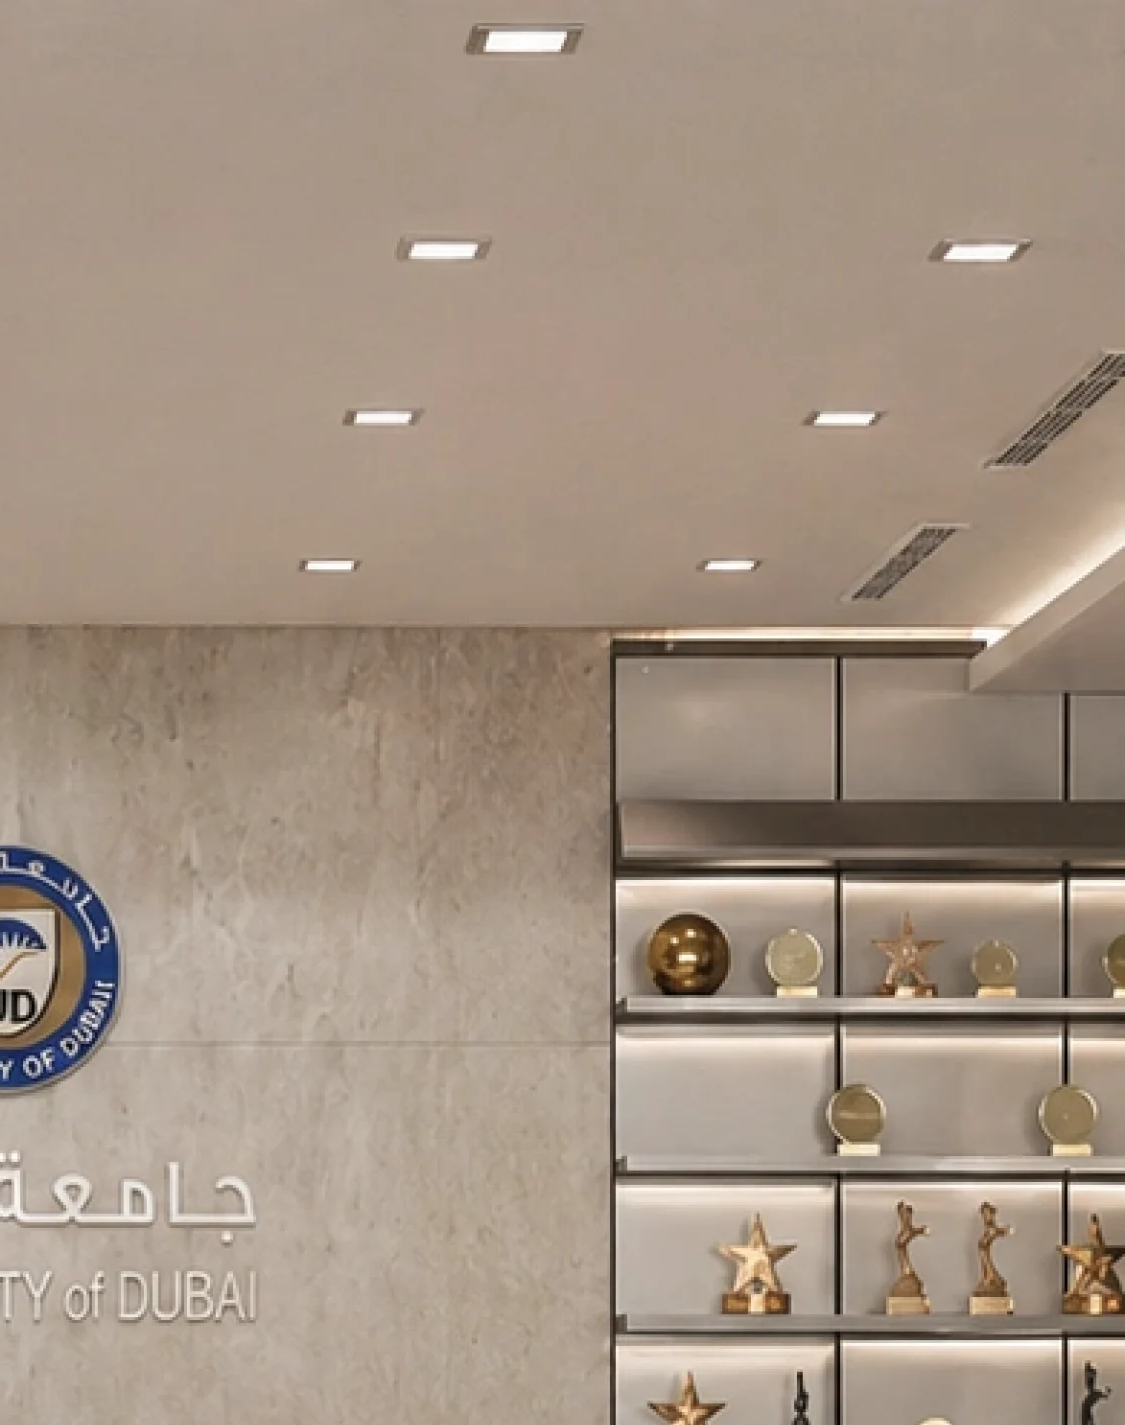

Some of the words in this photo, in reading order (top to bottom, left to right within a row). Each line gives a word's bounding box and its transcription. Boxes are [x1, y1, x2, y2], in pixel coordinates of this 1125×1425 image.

[22, 1046, 56, 1079] OF
[64, 1270, 107, 1323] of
[117, 1270, 258, 1323] DUBAI
